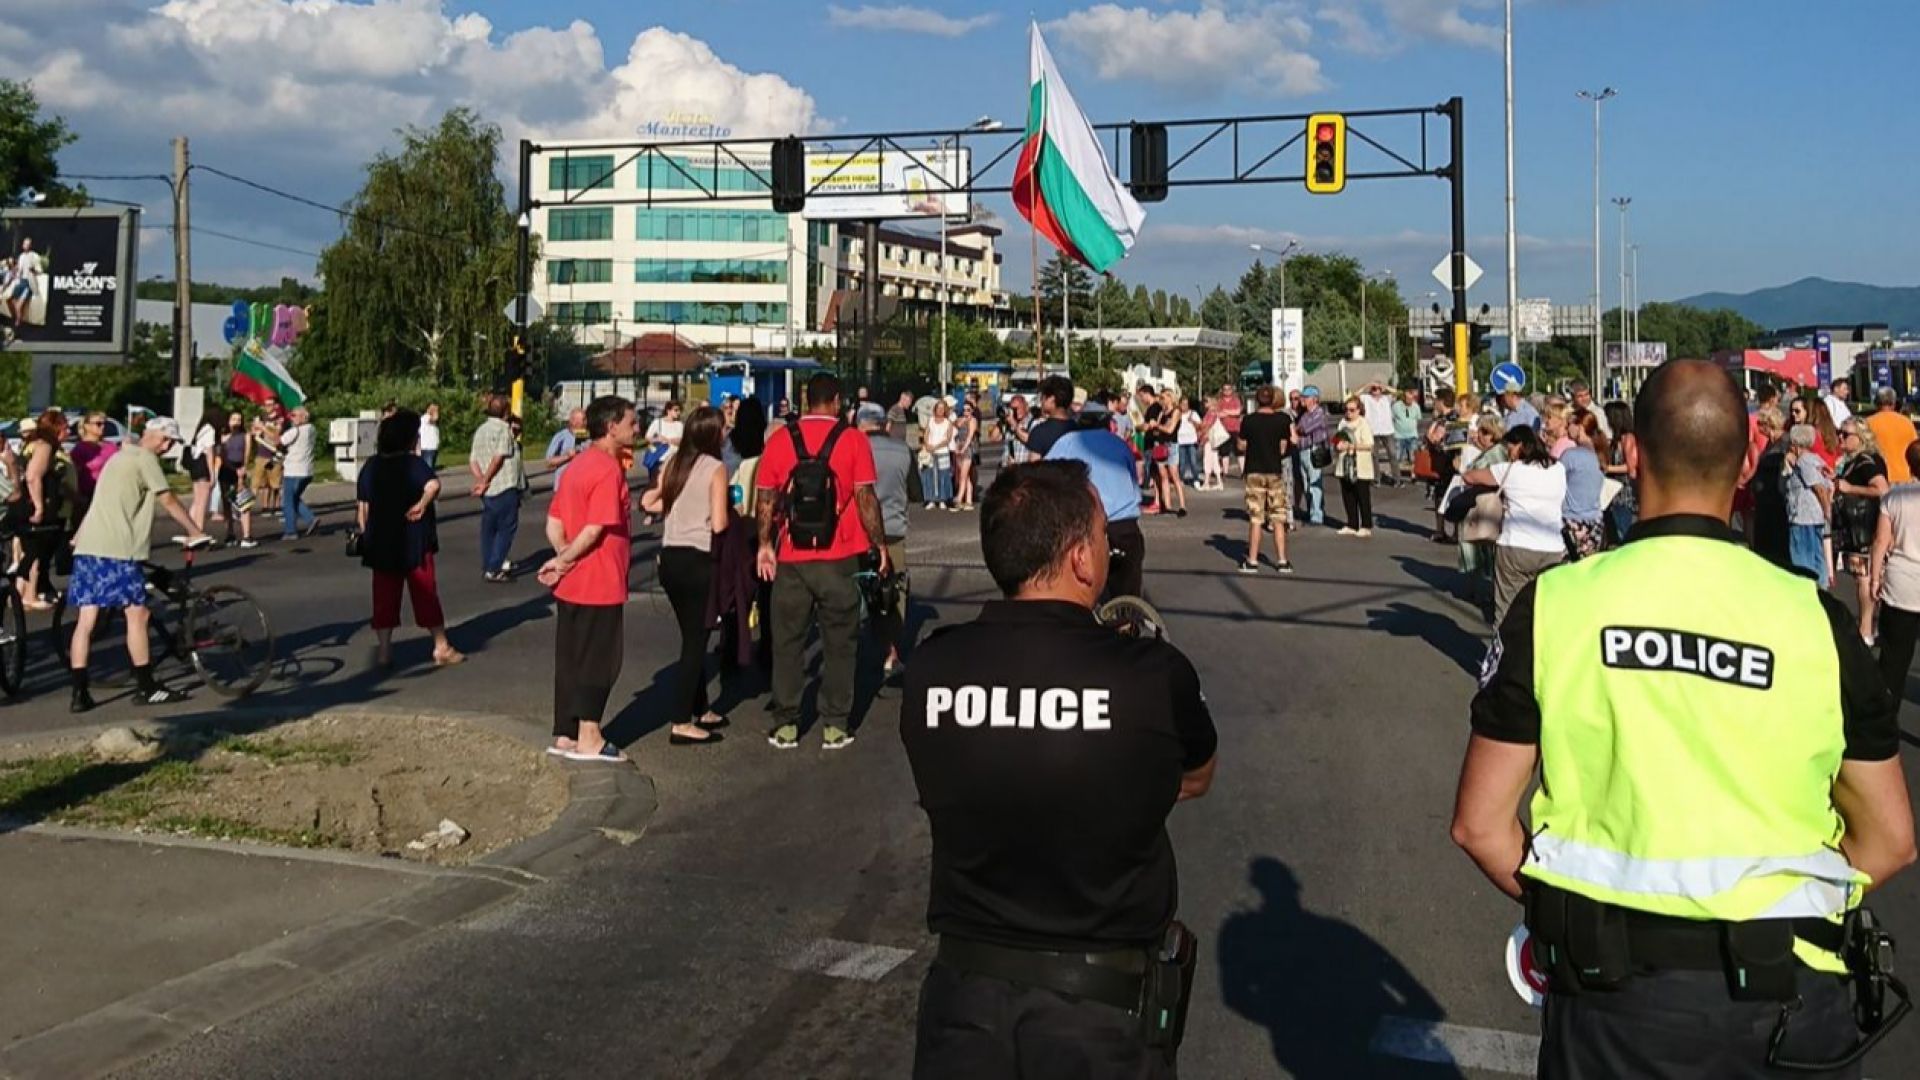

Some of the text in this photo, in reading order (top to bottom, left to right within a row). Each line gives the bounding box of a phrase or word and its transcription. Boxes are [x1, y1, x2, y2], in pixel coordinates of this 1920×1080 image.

[53, 275, 117, 290] MASON'S
[1604, 629, 1769, 685] POLICE
[926, 685, 1111, 730] POLICE
